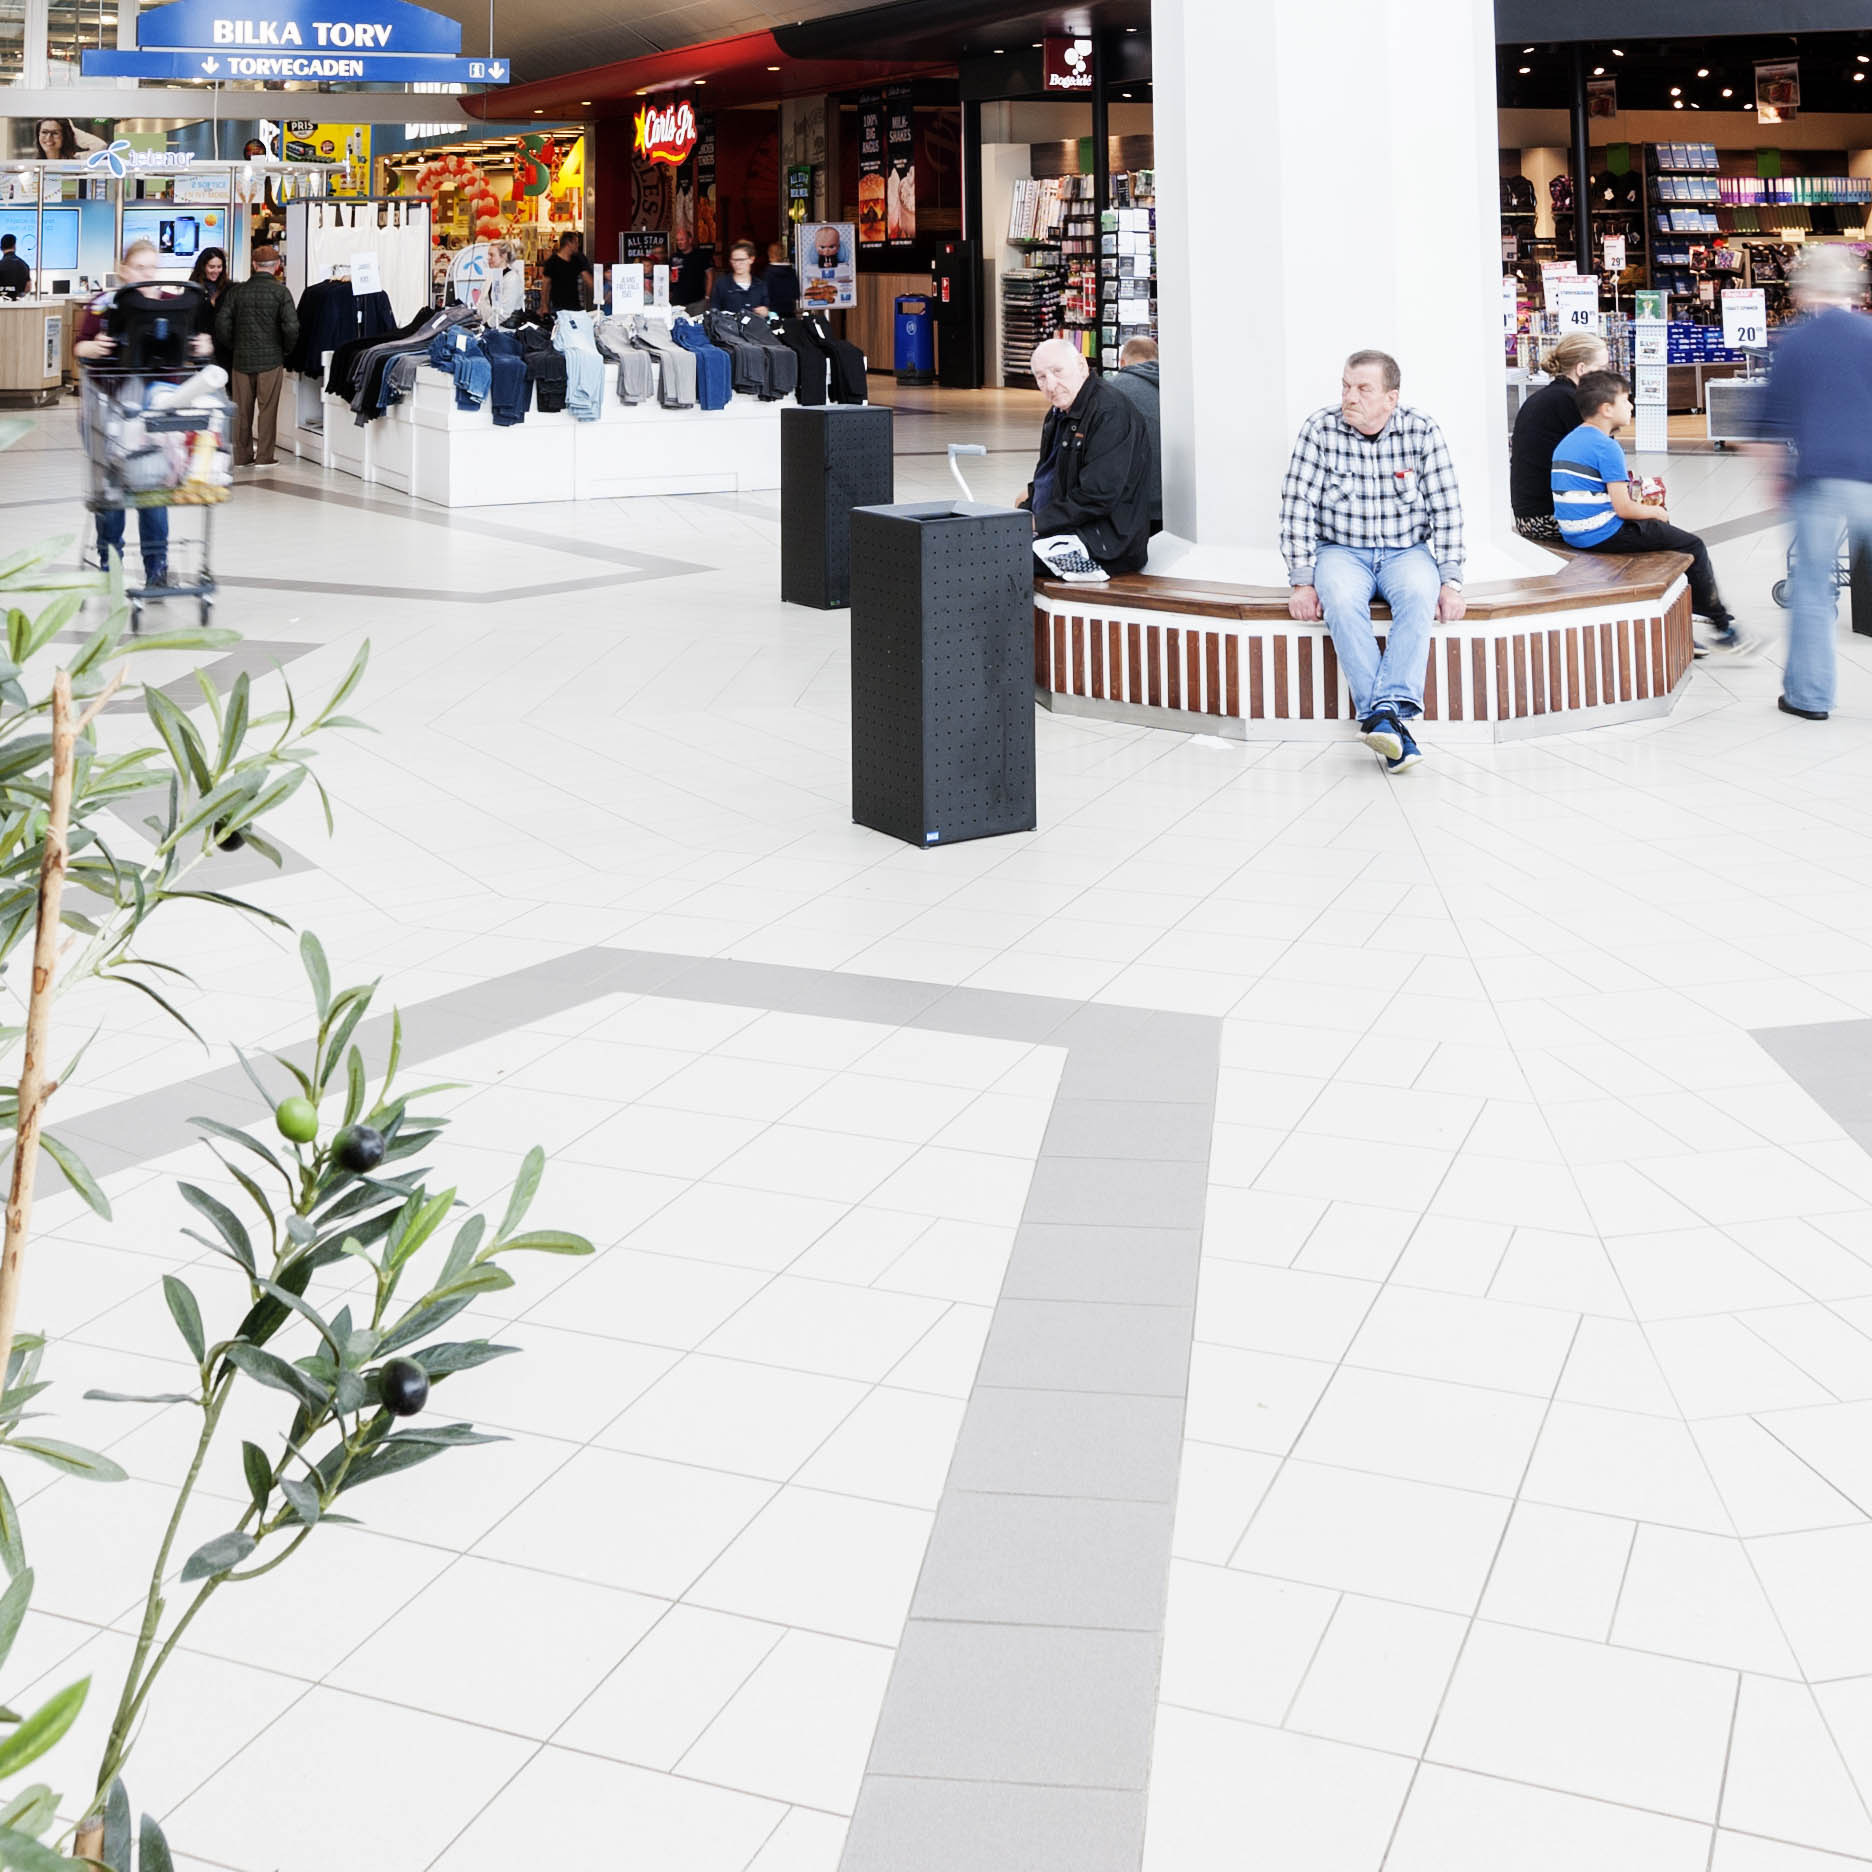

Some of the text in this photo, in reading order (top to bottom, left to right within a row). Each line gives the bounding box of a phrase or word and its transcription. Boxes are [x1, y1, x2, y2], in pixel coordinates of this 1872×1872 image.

[213, 20, 393, 48] BILKA TORV
[227, 57, 363, 77] TORVEGADEN
[1049, 73, 1092, 88] Bog&idé
[291, 121, 314, 130] PRIS
[644, 105, 696, 148] Carl's Jr.
[128, 148, 195, 166] telenor
[1611, 256, 1621, 266] 29
[1571, 310, 1589, 325] 49
[1737, 327, 1756, 342] 20
